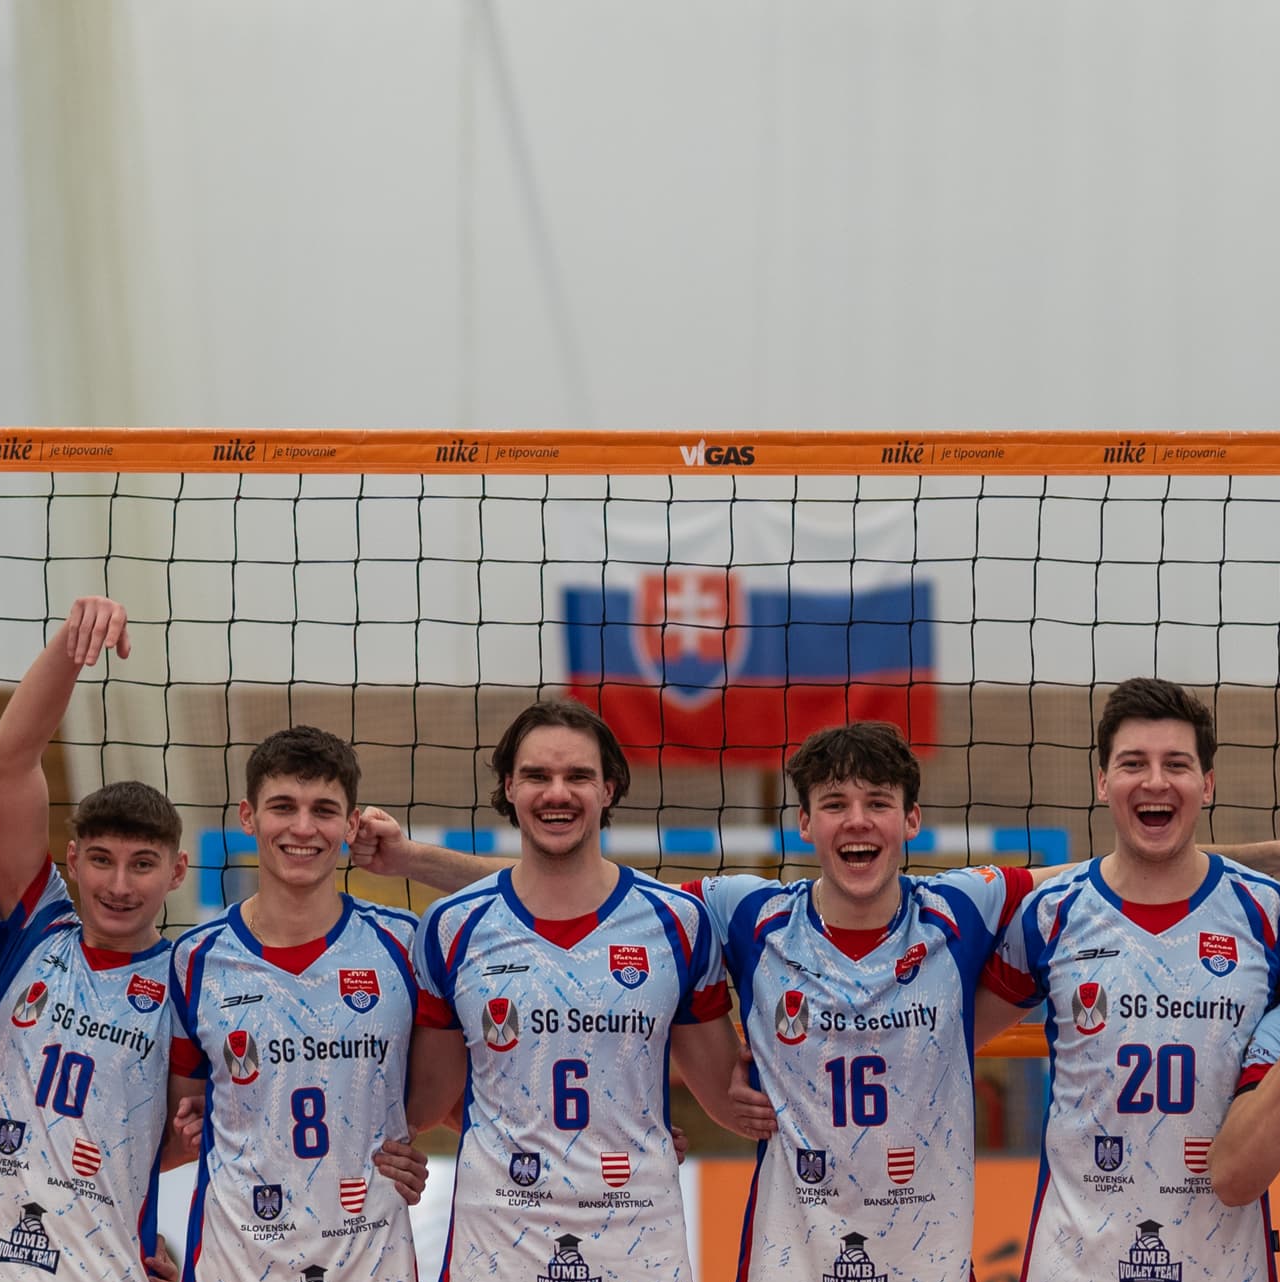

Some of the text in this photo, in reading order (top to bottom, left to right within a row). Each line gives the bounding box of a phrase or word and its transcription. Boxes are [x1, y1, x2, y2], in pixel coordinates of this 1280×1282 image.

[49, 444, 60, 458] je
[63, 443, 114, 458] tipovanie
[214, 439, 337, 461] niké je tipovanie
[436, 439, 560, 462] niké je tipovanie
[882, 441, 1005, 463] niké je tipovanie
[1104, 440, 1227, 463] niké je tipovanie
[820, 1002, 938, 1032] SG Security
[1119, 993, 1246, 1028] SG Security
[52, 1003, 155, 1061] SG Security
[531, 1008, 656, 1041] SG Security
[270, 1033, 389, 1065] SG Security
[35, 1044, 95, 1119] 10
[1116, 1043, 1196, 1115] 20
[552, 1059, 590, 1131] 6
[825, 1055, 888, 1128] 16
[291, 1087, 329, 1159] 8
[1083, 1174, 1135, 1185] SLOVENSKÁ
[1095, 1183, 1124, 1193] ĽUPČA
[495, 1188, 553, 1200] SLOVENSKÁ
[602, 1191, 630, 1200] MESTO
[888, 1187, 915, 1197] MESTO
[1159, 1185, 1195, 1194] BANSKÁ
[508, 1197, 541, 1208] ĽUPČA
[578, 1199, 654, 1209] BANSKÁ BYSTRICA
[864, 1193, 936, 1206] BANSKÁ BYSTRICA
[240, 1221, 297, 1232] SLOVENSKÁ
[12, 1231, 49, 1249] UMB
[253, 1231, 285, 1241] ĽUPČA
[32, 1251, 58, 1268] TEAM
[1131, 1250, 1169, 1265] UMB
[549, 1264, 588, 1281] UMB
[835, 1263, 874, 1278] UMB
[1120, 1261, 1181, 1282] VOLLEY TEAM
